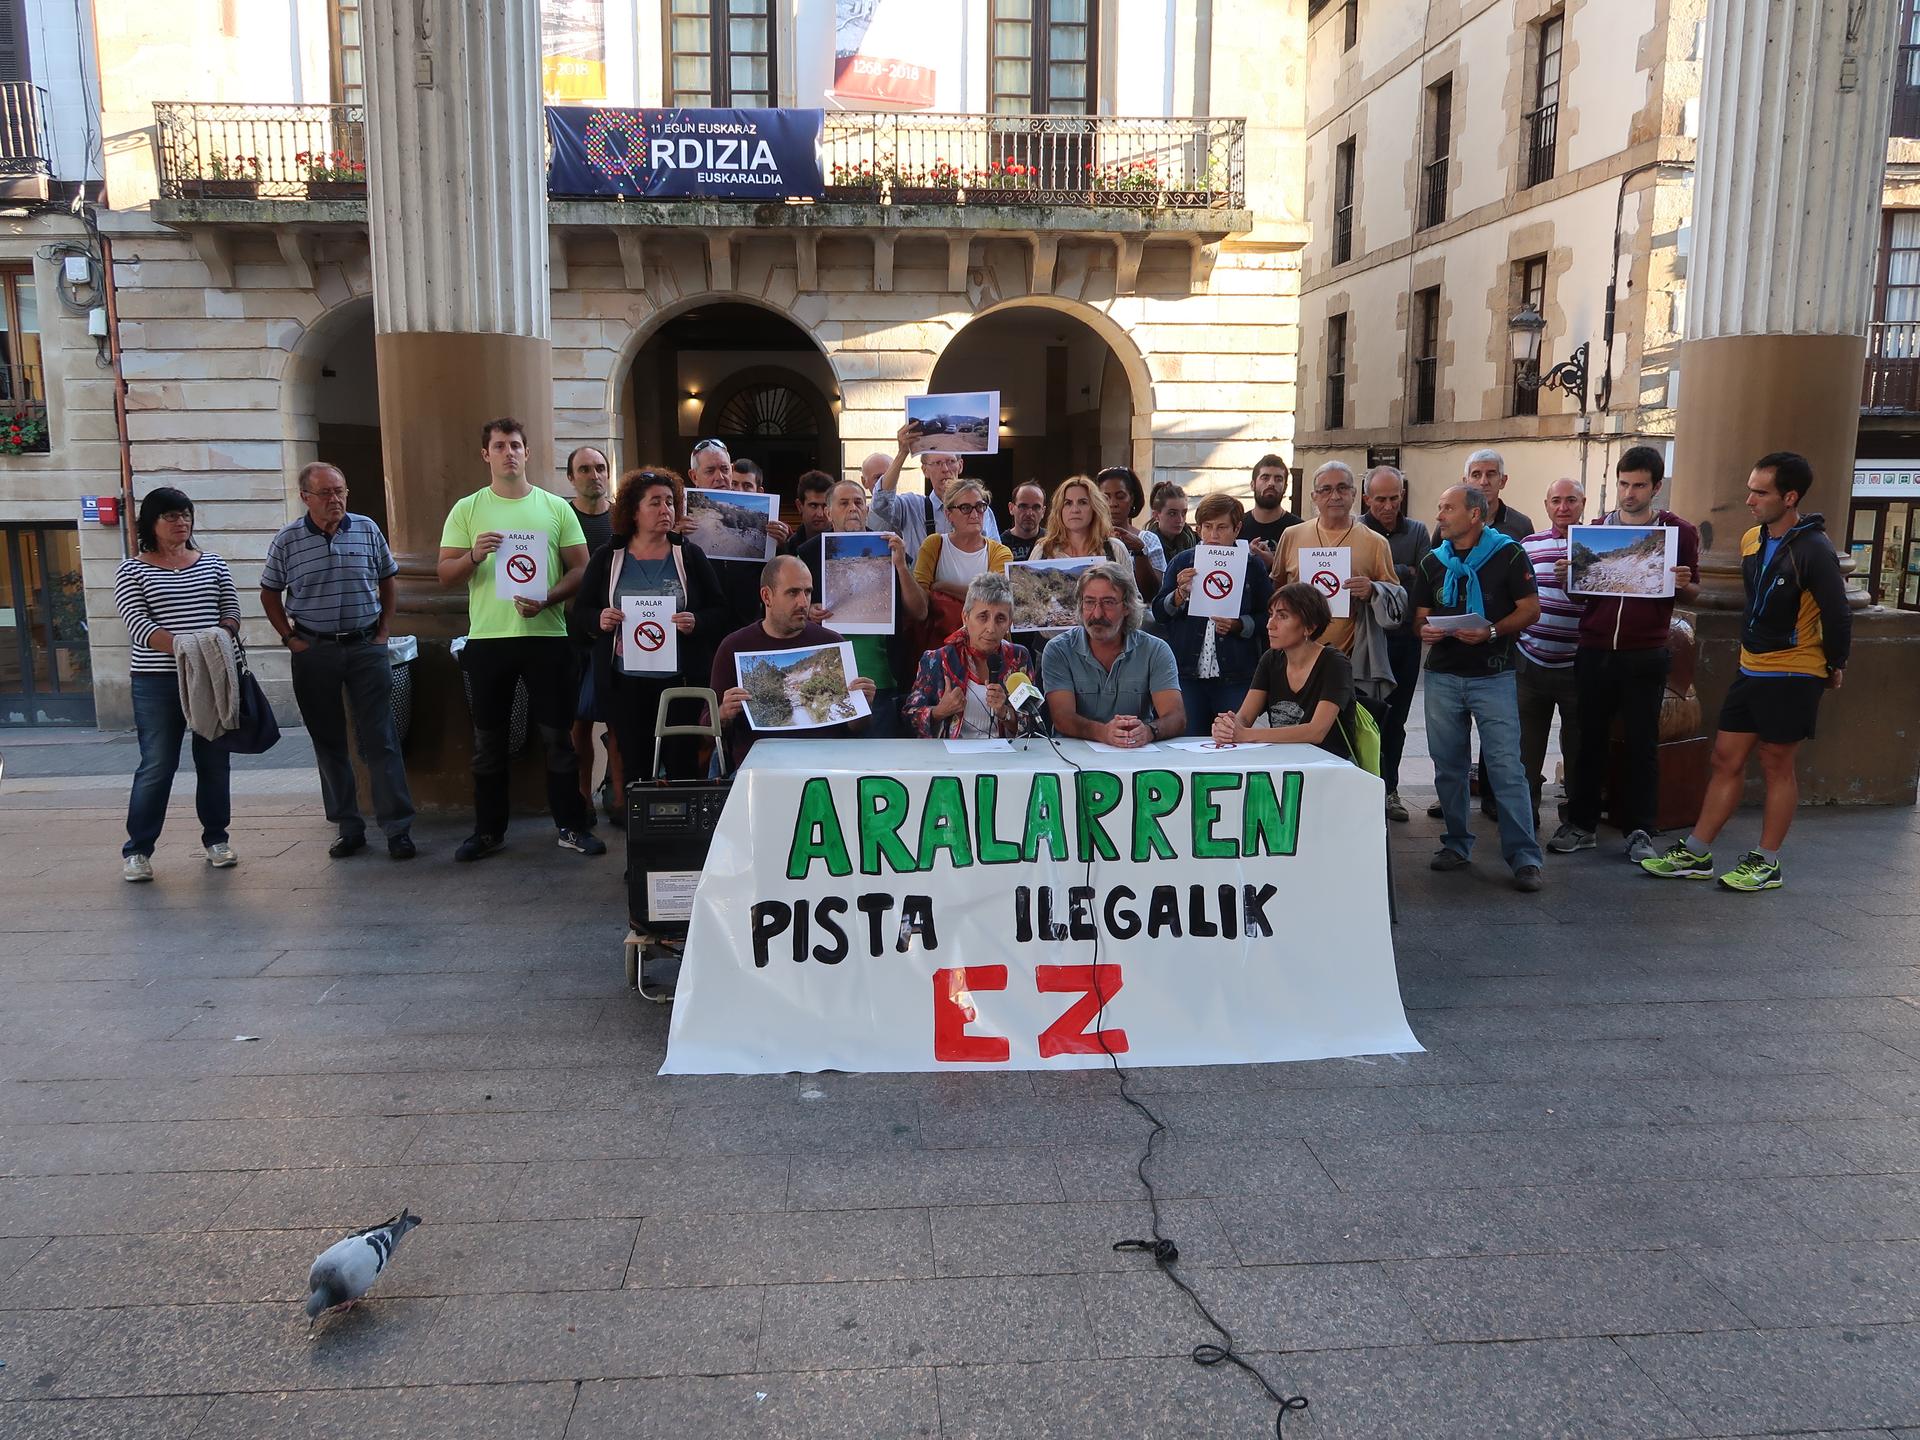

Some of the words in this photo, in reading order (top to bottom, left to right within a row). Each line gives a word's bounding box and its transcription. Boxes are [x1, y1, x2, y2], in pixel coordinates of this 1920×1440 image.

[853, 59, 919, 81] 1268-2018
[651, 124, 661, 134] 11
[664, 123, 696, 134] EGUN
[698, 123, 757, 135] EUSKARAZ
[697, 172, 783, 185] EUSKARALDIA
[508, 533, 535, 541] ARALAR
[1207, 549, 1235, 557] ARALAR
[1214, 560, 1227, 568] SOS
[786, 770, 1303, 880] ARALARREN
[750, 895, 939, 969] PISTA
[1015, 884, 1279, 942] ILEGALIK
